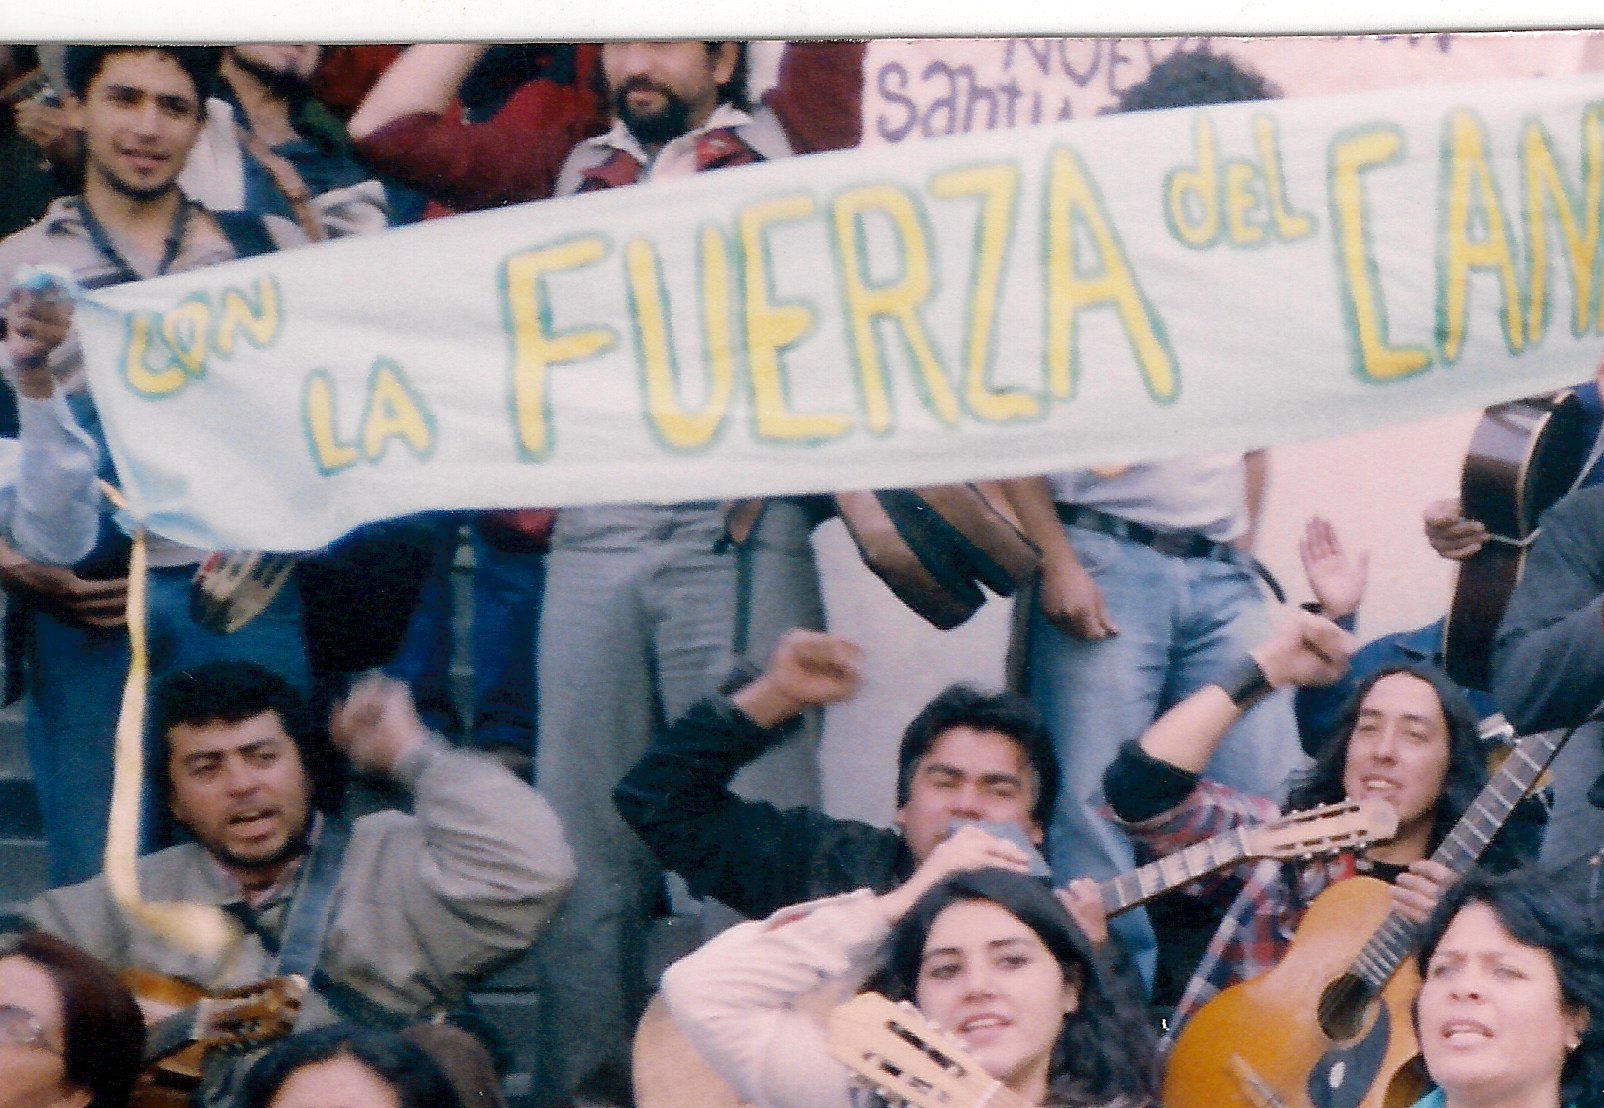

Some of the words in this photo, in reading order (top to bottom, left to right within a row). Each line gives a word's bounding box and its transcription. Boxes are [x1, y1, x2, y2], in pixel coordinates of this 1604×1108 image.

[117, 272, 284, 400] CON
[301, 354, 438, 478] LA
[500, 143, 1183, 462] FUERZA
